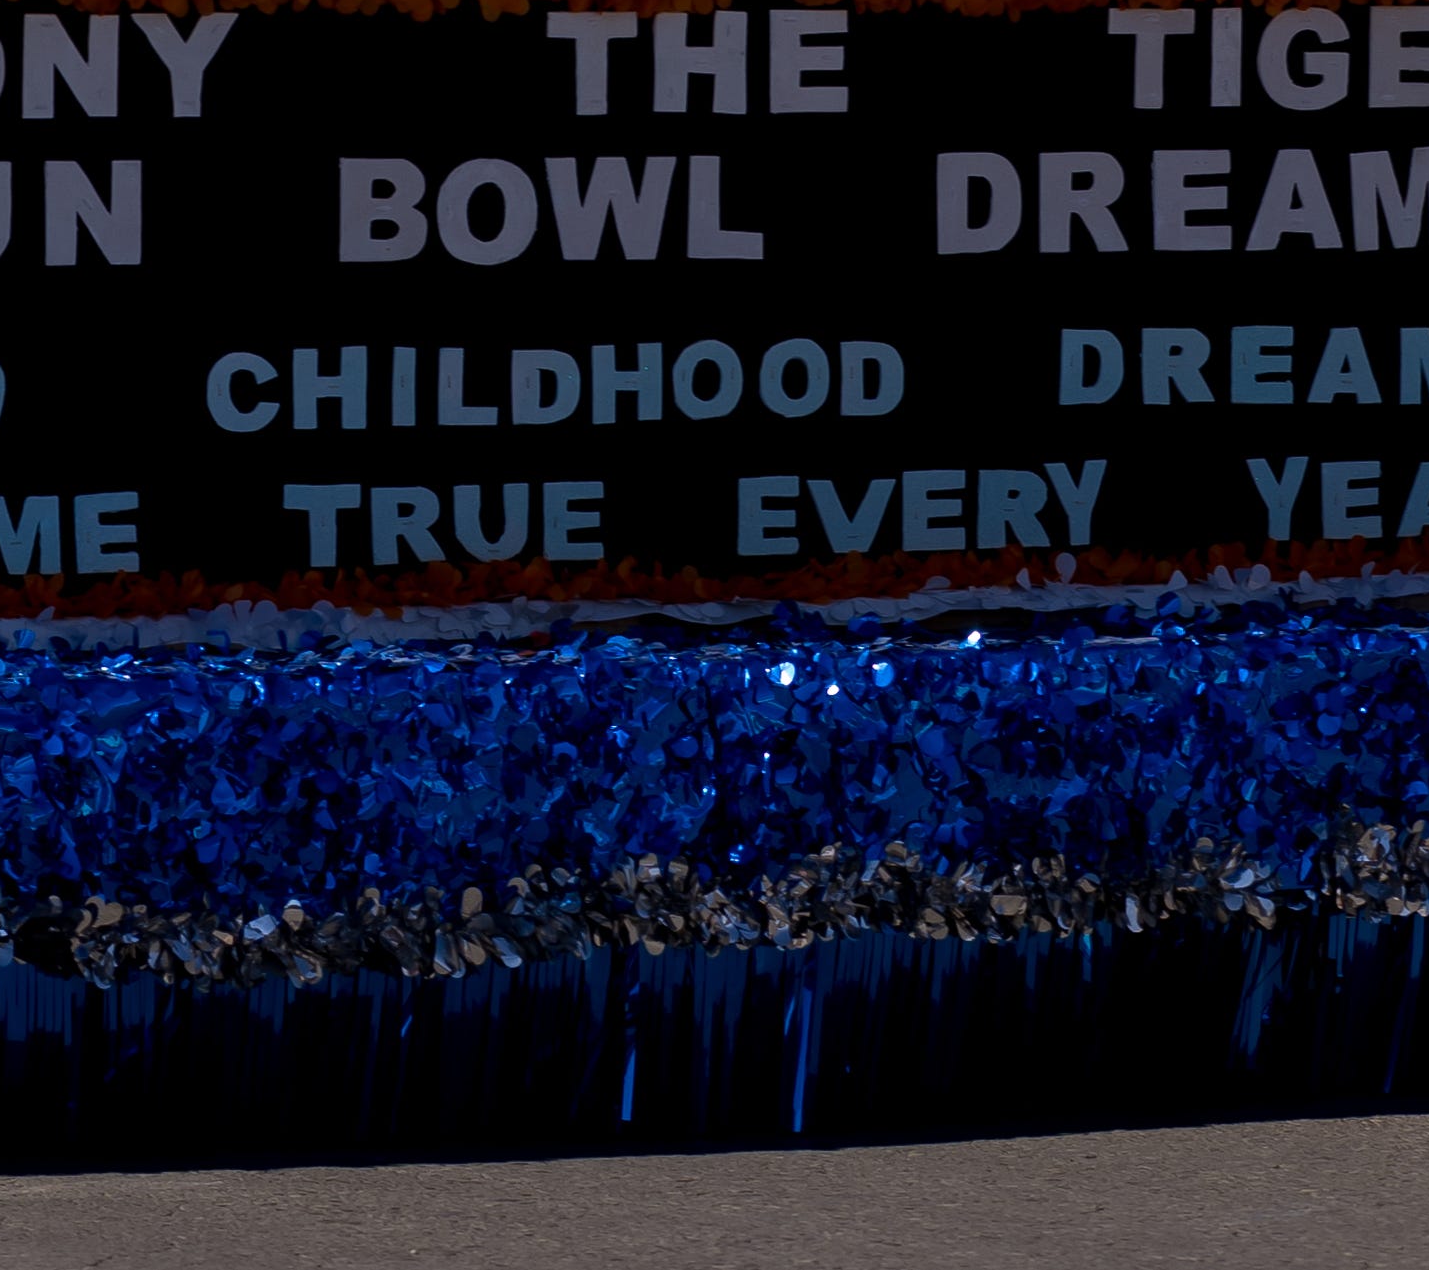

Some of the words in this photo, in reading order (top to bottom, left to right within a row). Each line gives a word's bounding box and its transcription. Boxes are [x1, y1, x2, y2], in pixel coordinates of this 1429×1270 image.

[546, 8, 849, 116] THE
[338, 155, 764, 264] BOWL
[207, 338, 904, 434] CHILDHOOD
[282, 481, 604, 569] TRUE
[737, 459, 1106, 557] EVERY
